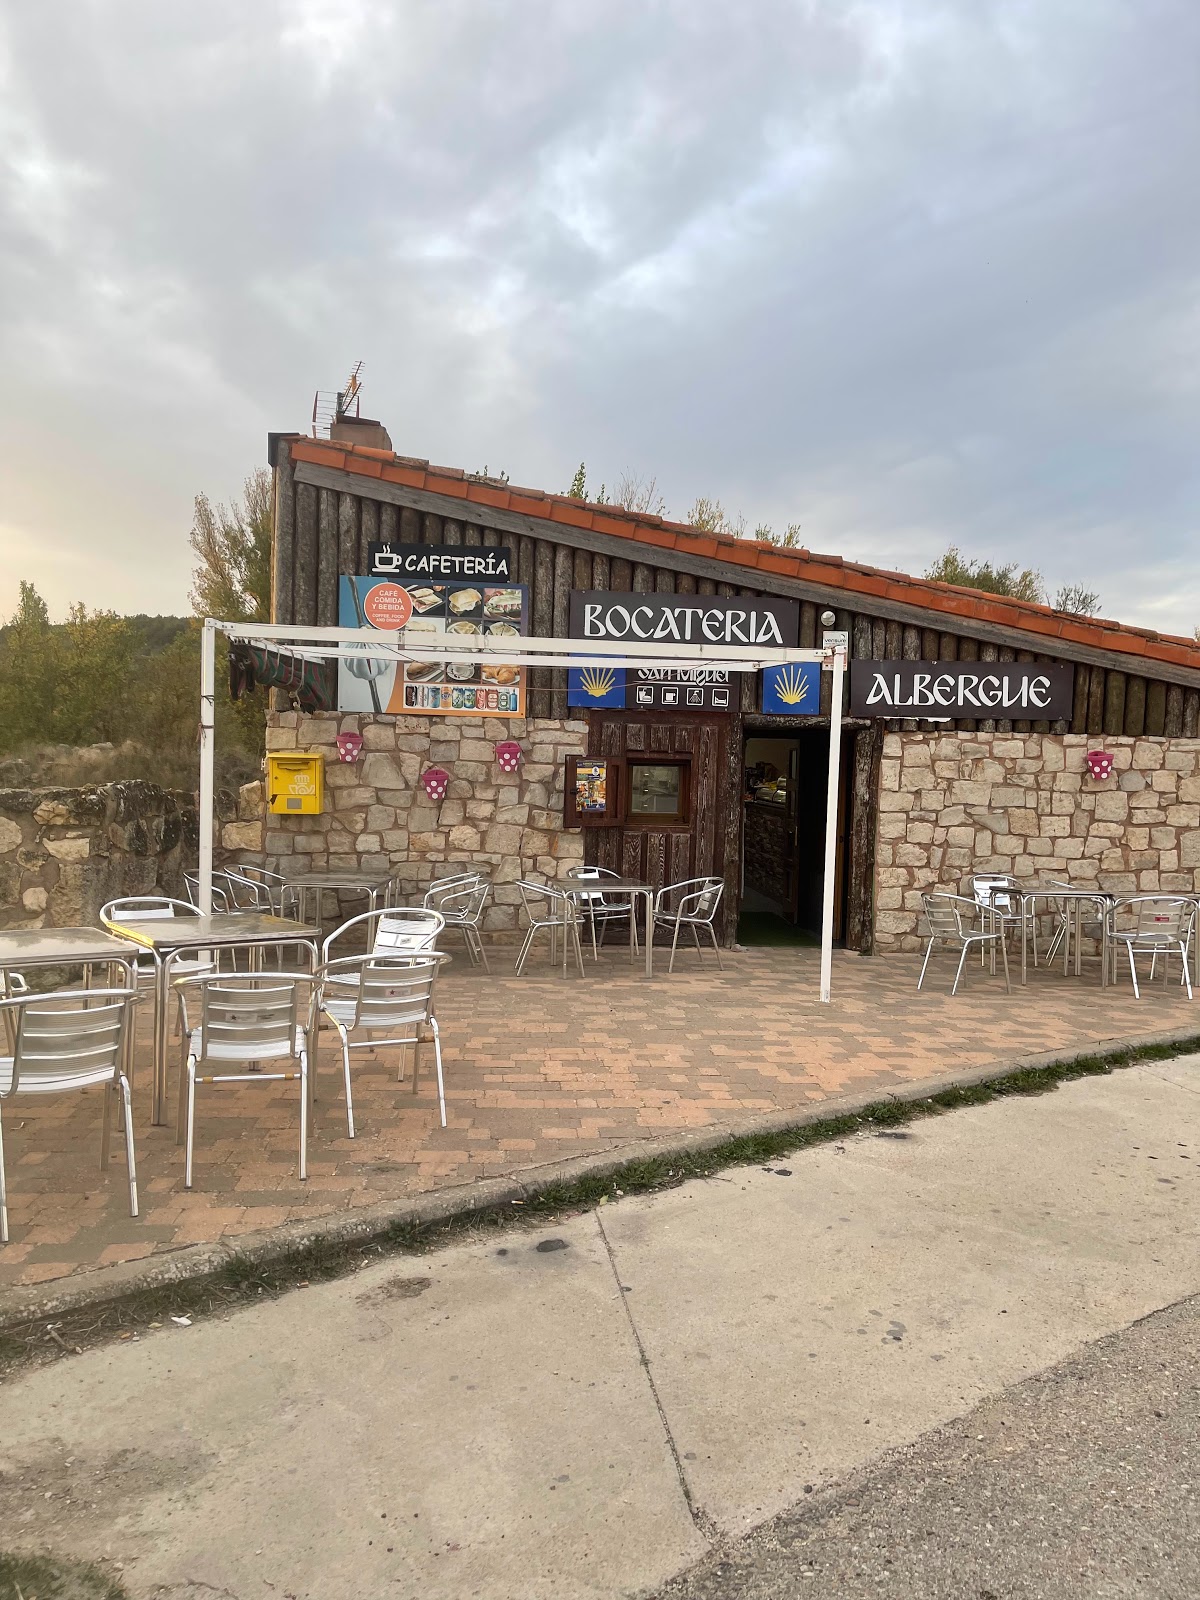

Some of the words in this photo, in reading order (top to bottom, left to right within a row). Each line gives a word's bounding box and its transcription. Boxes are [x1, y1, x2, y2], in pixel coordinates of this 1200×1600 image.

[404, 552, 509, 576] CAFETERÍA
[378, 603, 405, 611] BEBIDA
[584, 604, 784, 644] BOCATERIA
[865, 673, 1052, 708] ALBERGUE
